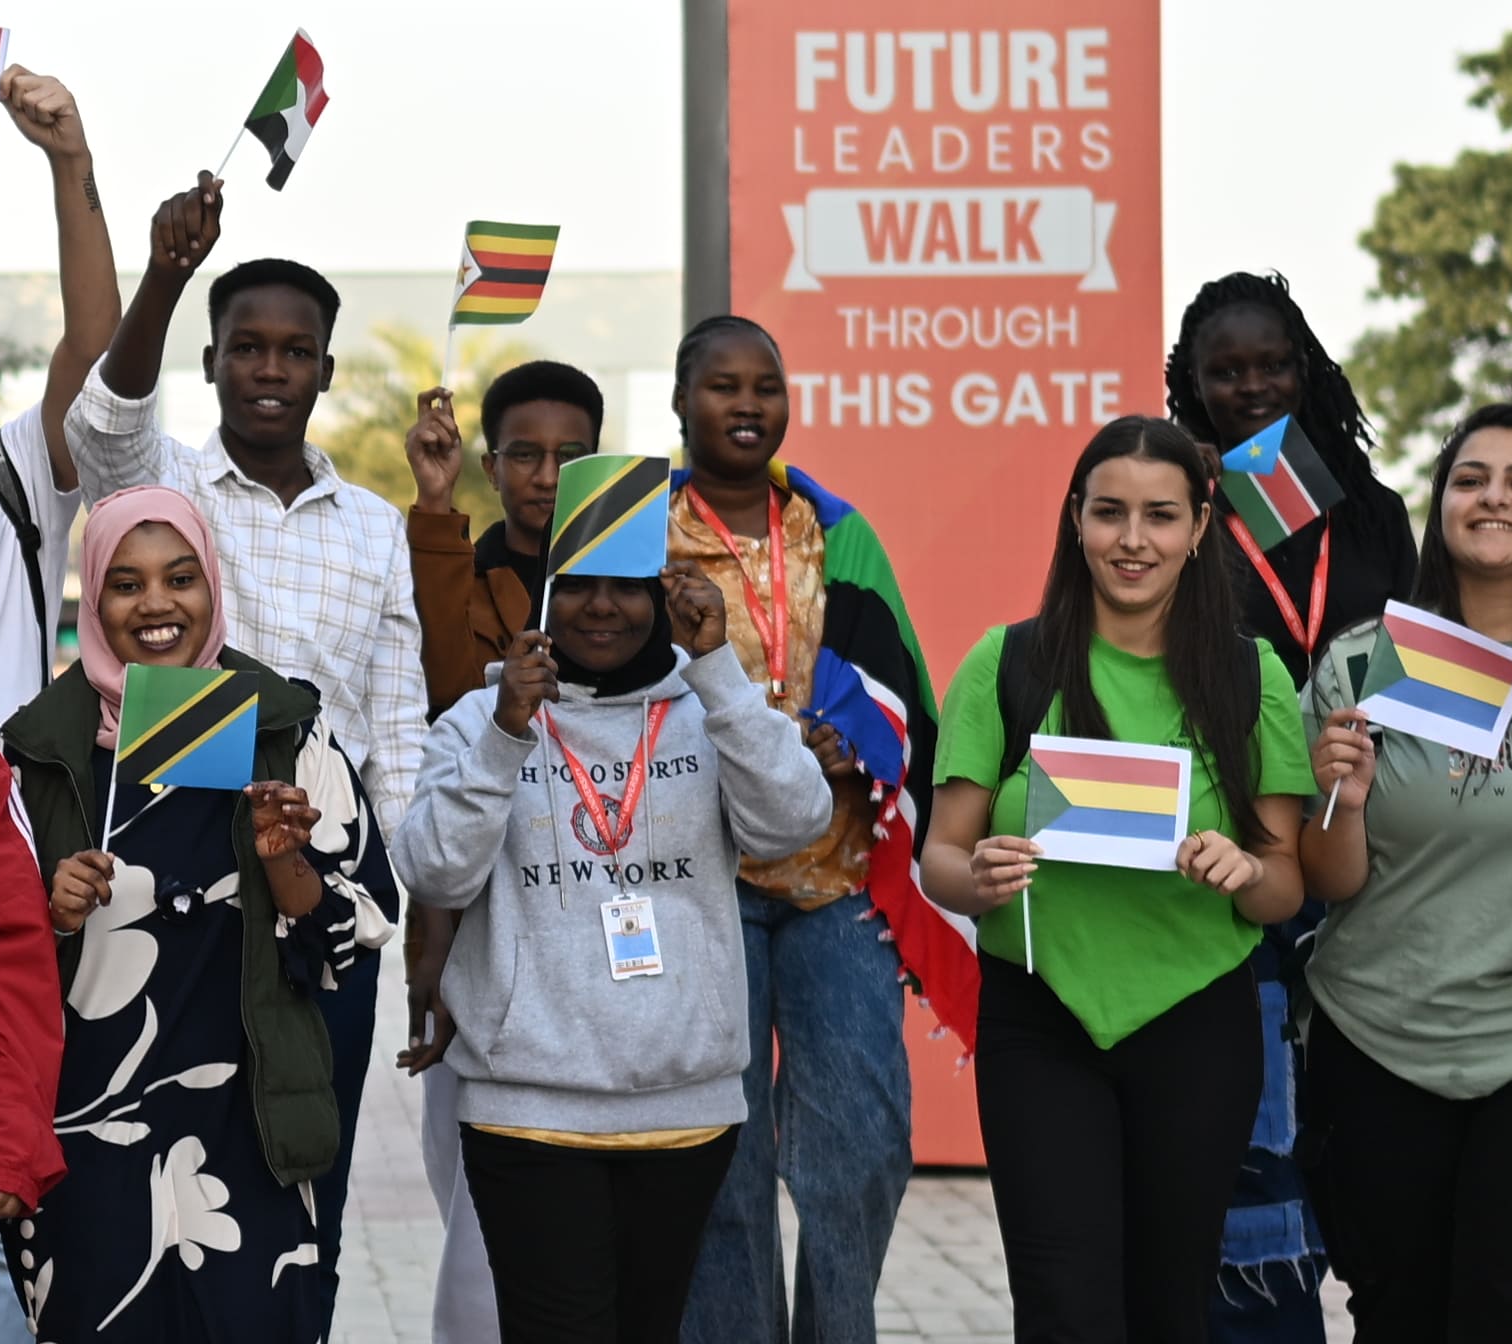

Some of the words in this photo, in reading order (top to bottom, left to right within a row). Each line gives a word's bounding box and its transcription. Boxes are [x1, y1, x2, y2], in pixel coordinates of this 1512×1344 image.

[794, 28, 1111, 114] FUTURE
[794, 122, 1112, 173] LEADERS
[859, 200, 1041, 264] WALK
[838, 305, 1079, 350] THROUGH
[789, 372, 933, 427] THIS
[951, 372, 1122, 427] GATE
[1450, 786, 1506, 798] NEW
[520, 859, 594, 888] NEW
[603, 856, 694, 886] YORK
